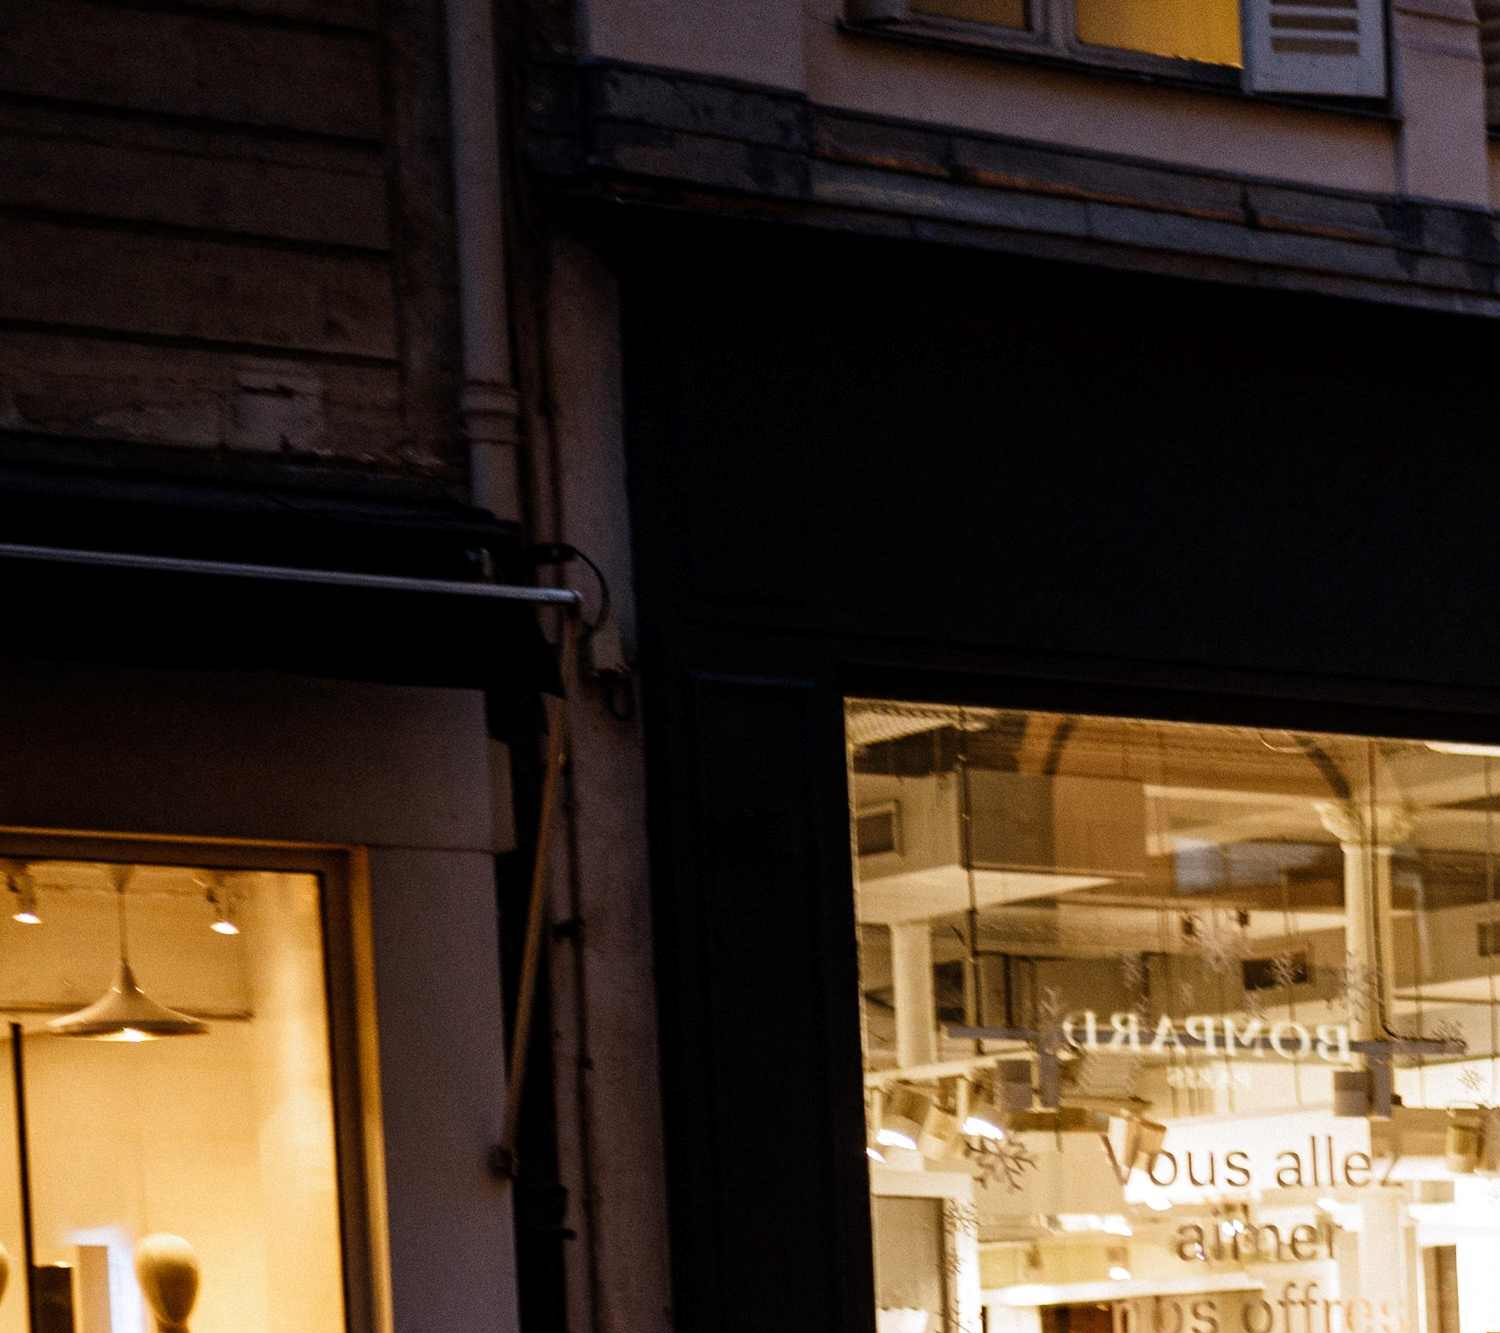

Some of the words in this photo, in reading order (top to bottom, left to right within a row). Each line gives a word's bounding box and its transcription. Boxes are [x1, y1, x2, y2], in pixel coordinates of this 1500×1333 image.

[1101, 1134, 1251, 1187] Vous
[1275, 1134, 1404, 1188] allez
[1173, 1207, 1344, 1263] aimer
